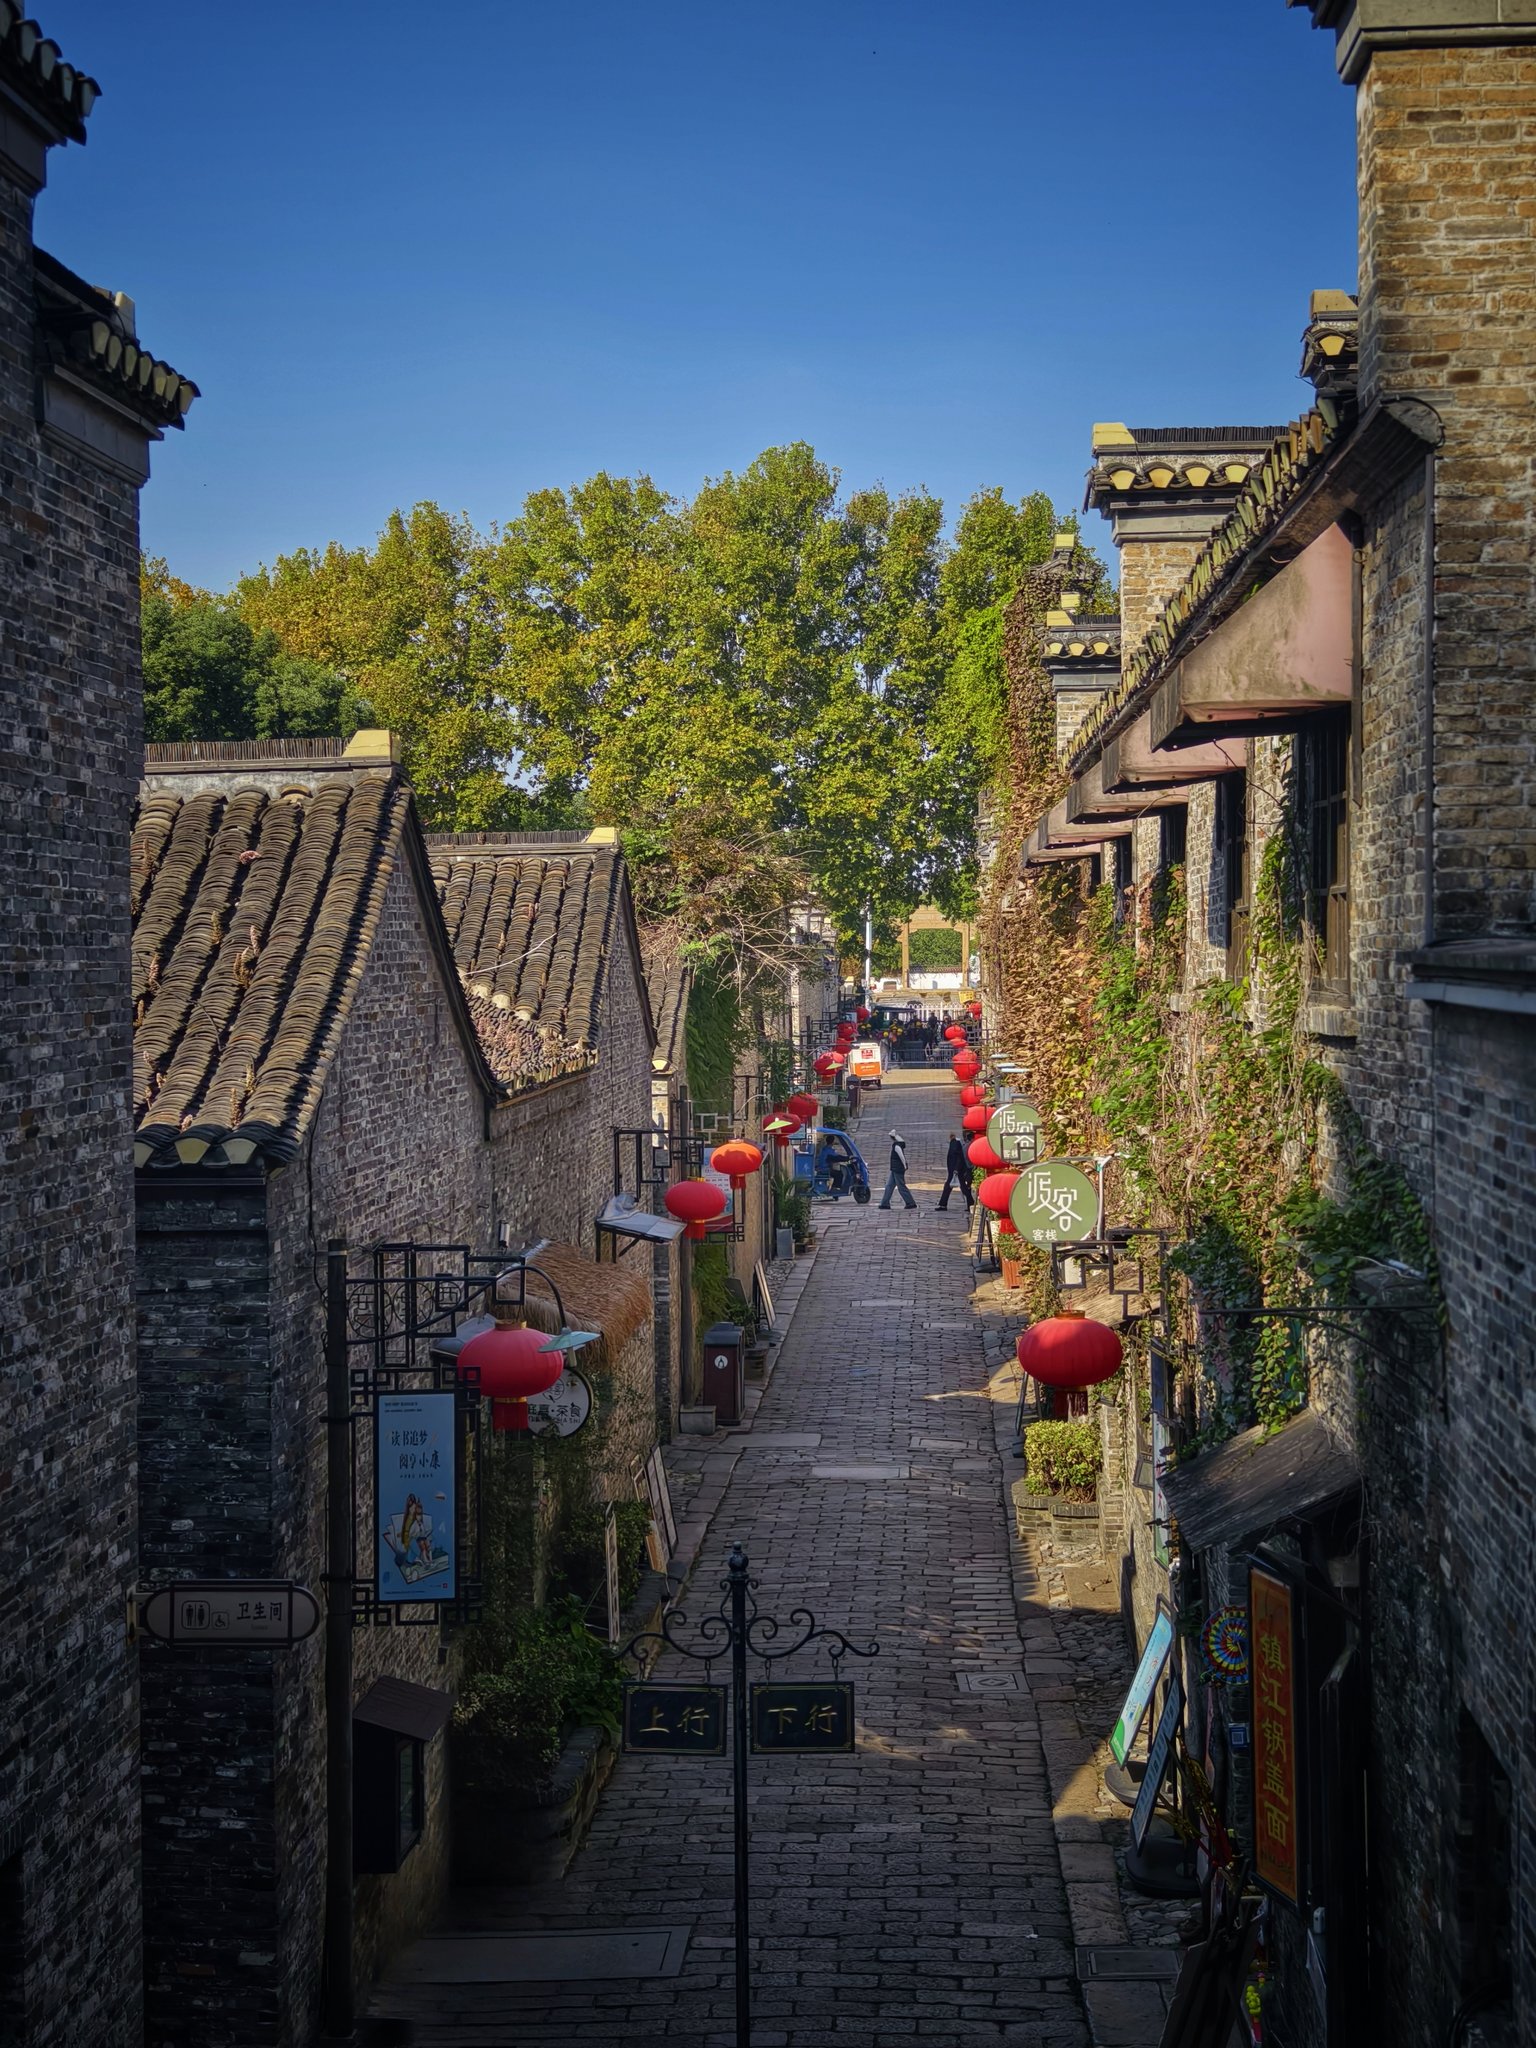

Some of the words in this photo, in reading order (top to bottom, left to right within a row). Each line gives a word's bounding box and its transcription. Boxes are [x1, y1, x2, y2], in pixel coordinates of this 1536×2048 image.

[1032, 1229, 1057, 1241] 客栈
[236, 1602, 282, 1622] 卫生间
[639, 1705, 710, 1736] 上行
[767, 1704, 838, 1734] 下行
[1259, 1632, 1290, 1847] 镇江锅盖面
